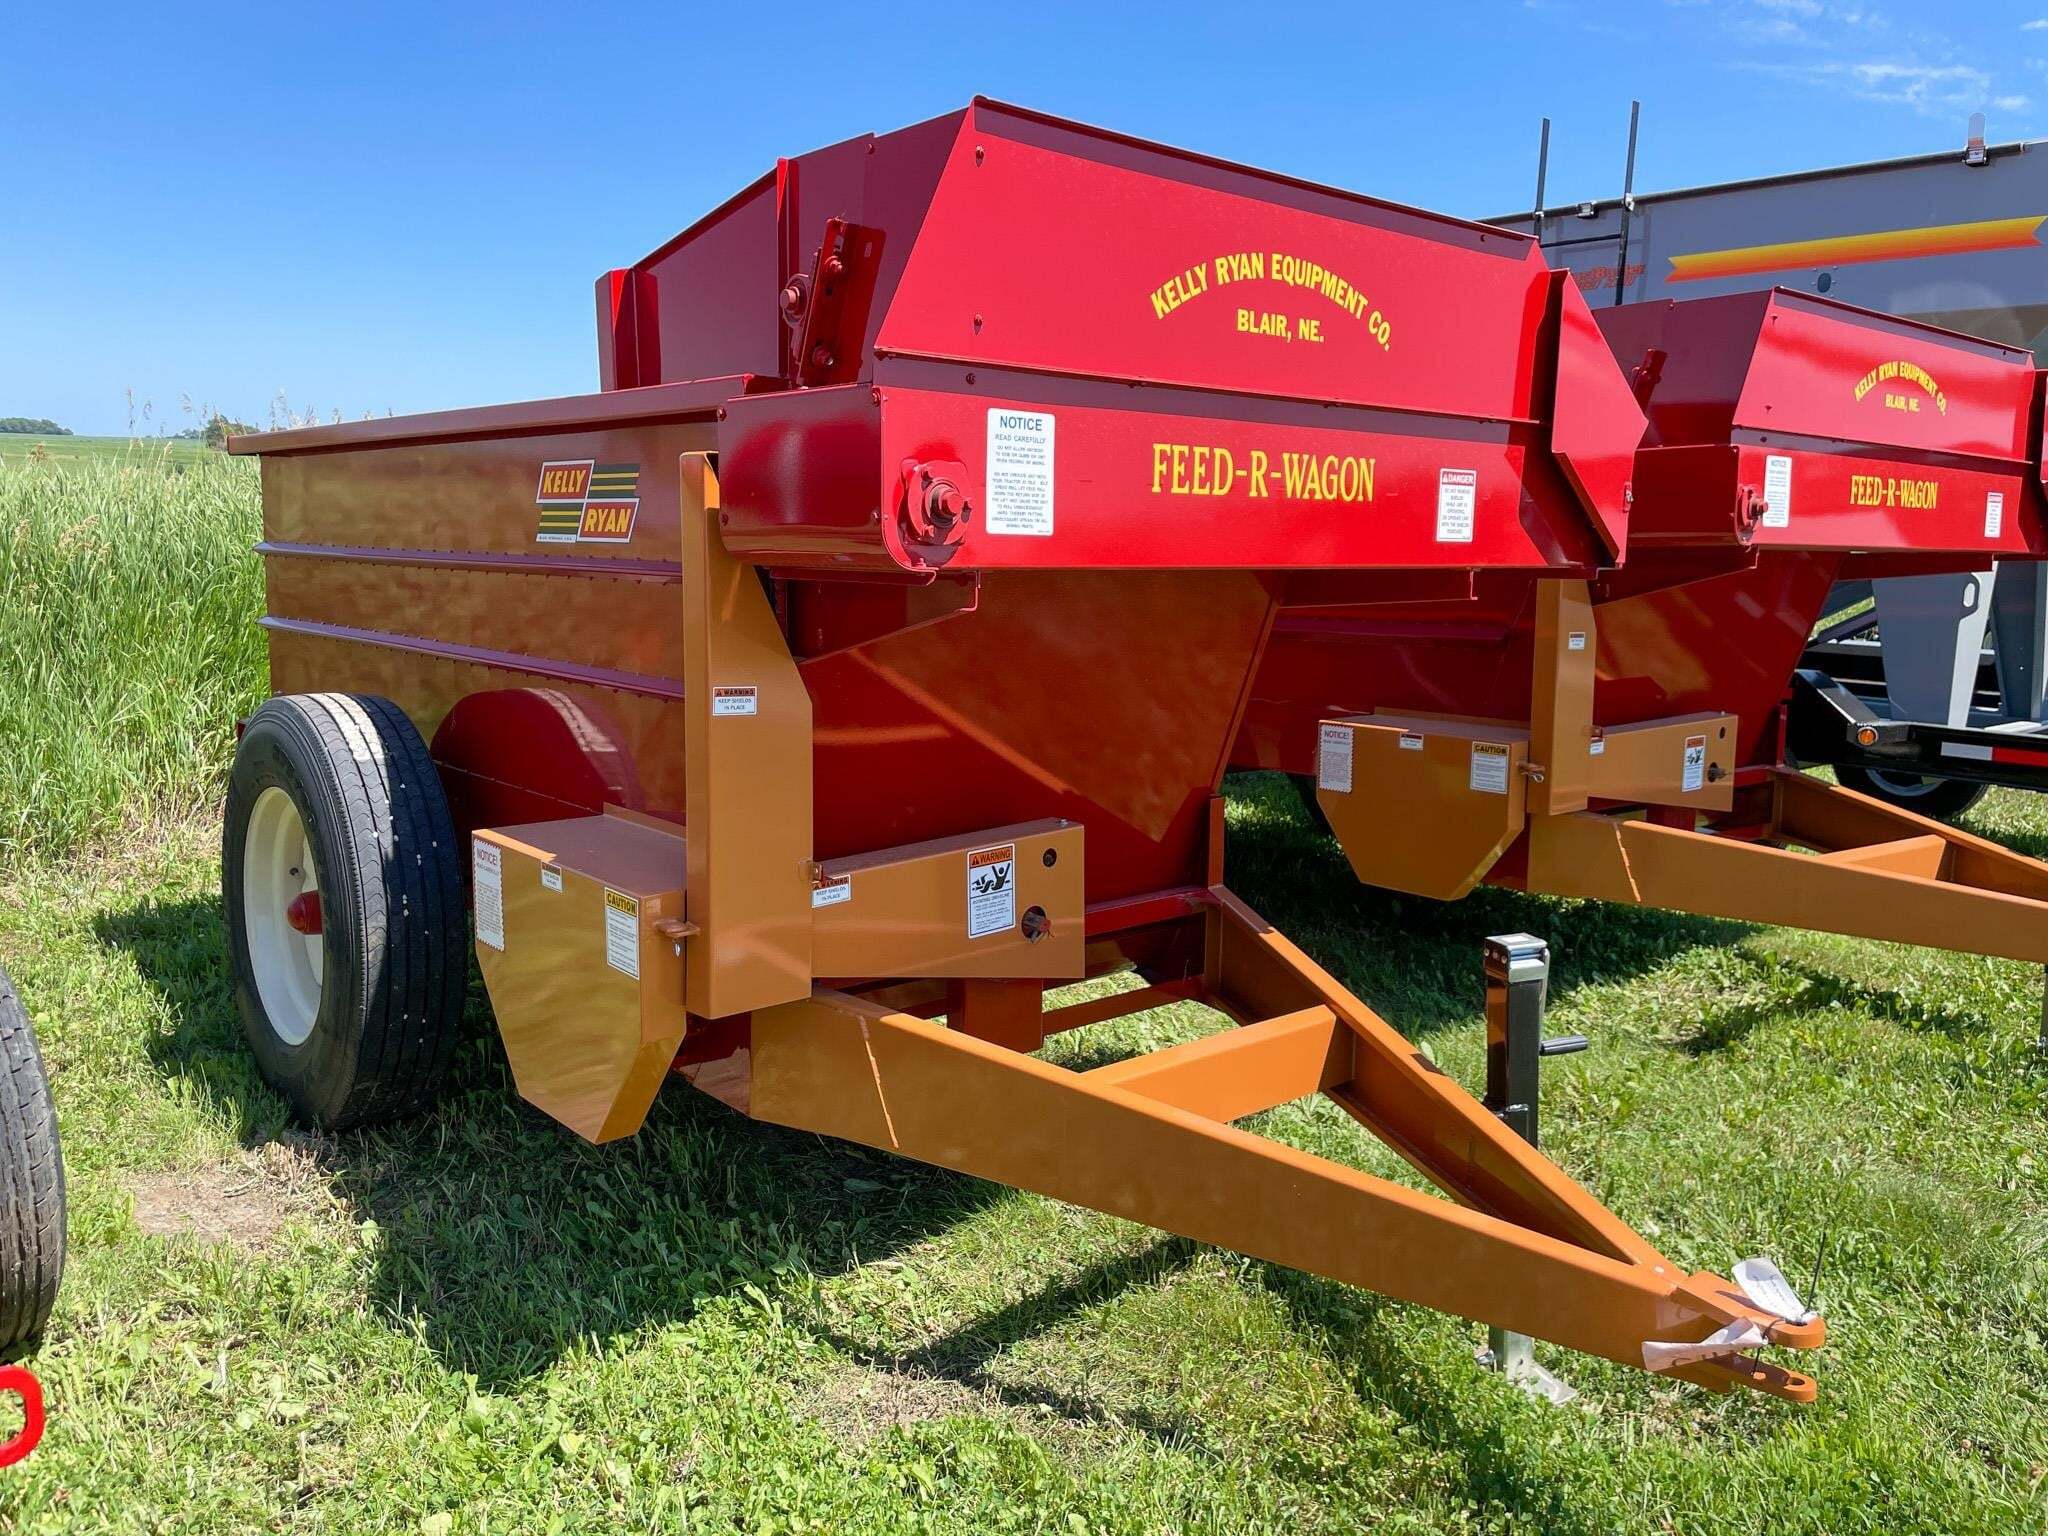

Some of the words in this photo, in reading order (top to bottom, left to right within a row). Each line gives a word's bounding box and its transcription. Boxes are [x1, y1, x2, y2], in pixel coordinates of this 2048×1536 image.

[1150, 262, 1208, 320] KELLY
[1215, 252, 1265, 286] RYAN
[1271, 253, 1369, 320] EQUIPMENT
[1368, 310, 1392, 352] CO.
[1237, 308, 1292, 343] BLAIR,
[1298, 318, 1325, 342] NE.
[1854, 368, 1877, 402] KELLY
[1879, 361, 1899, 381] RYAN
[1899, 361, 1938, 398] EQUIPMENT
[1000, 416, 1043, 431] NOTICE
[995, 433, 1012, 441] READ
[1014, 435, 1046, 444] CAREFULLY
[542, 469, 587, 493] KELLY
[1151, 443, 1376, 502] FEED-R-WAGON
[1448, 472, 1474, 484] DANGER
[1850, 475, 1938, 509] FEED-R-WAGON
[584, 508, 632, 532] RYAN
[1475, 745, 1507, 754] CAUTION
[980, 848, 1011, 862] WARNING
[607, 893, 636, 914] CAUTION
